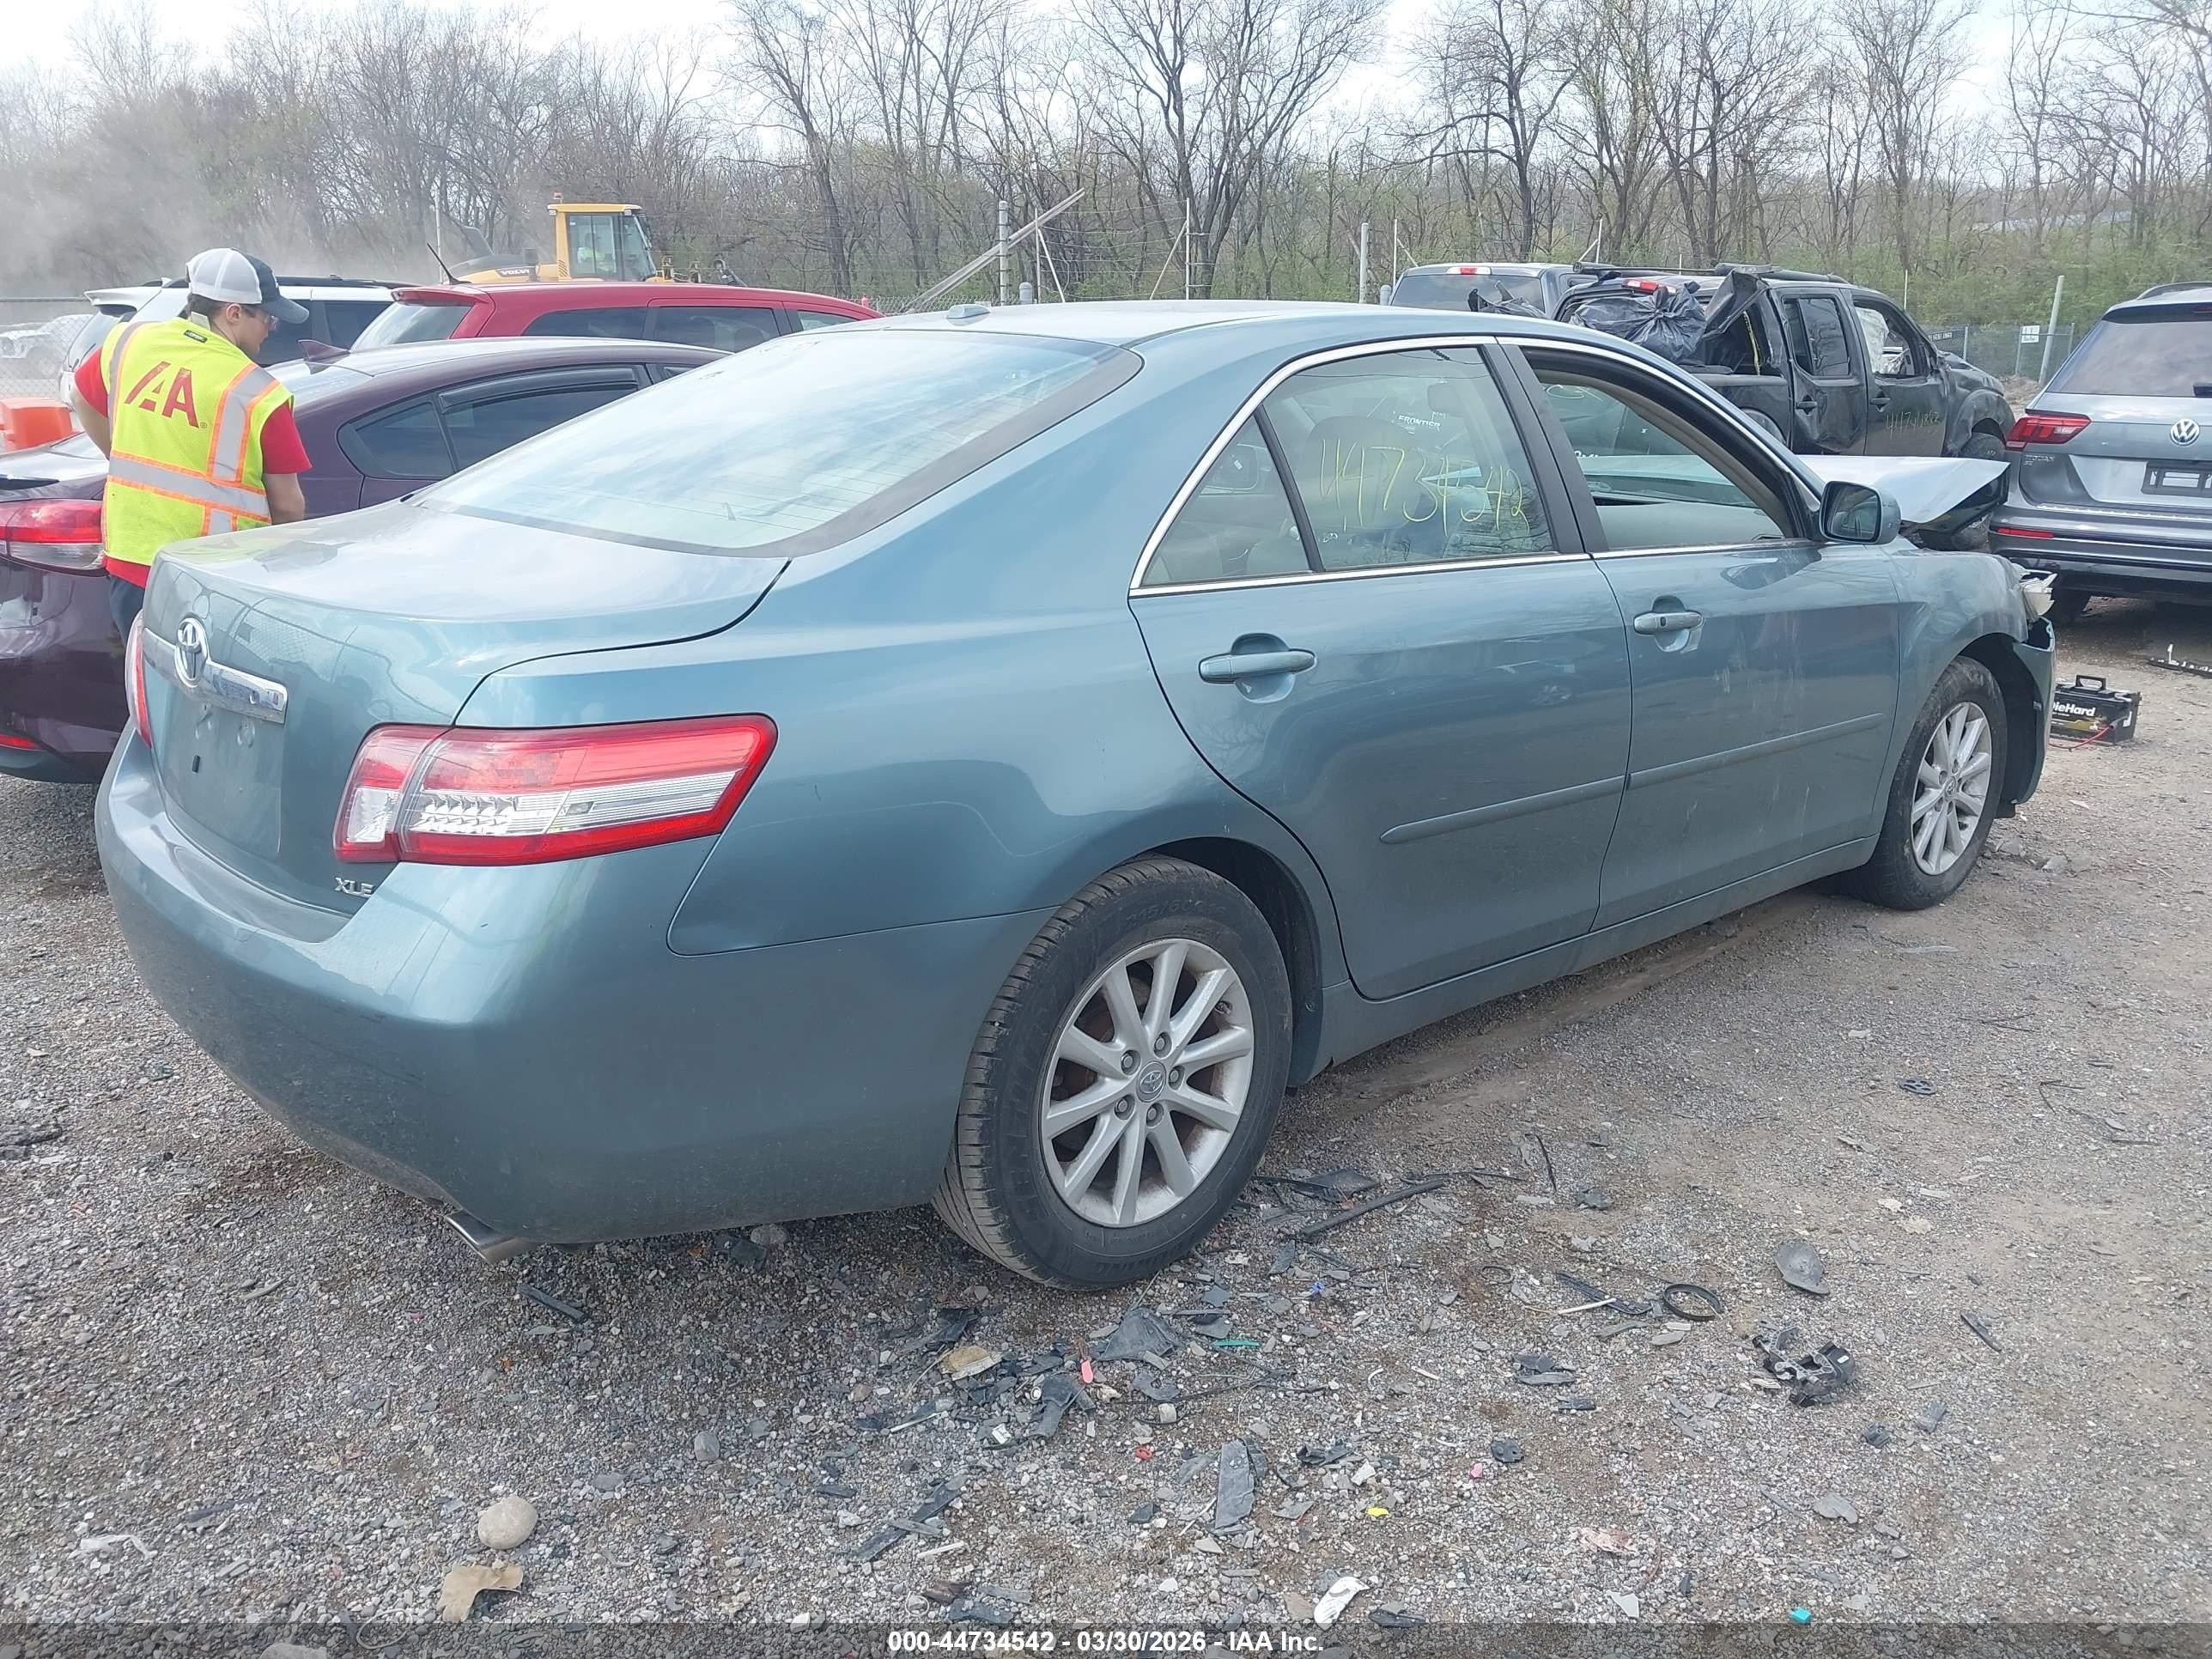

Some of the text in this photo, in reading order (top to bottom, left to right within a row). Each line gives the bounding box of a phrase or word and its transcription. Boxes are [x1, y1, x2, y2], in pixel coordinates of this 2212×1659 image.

[1398, 415, 1441, 431] FRONTIER
[1319, 438, 1530, 537] 44734542
[334, 877, 374, 898] XLE
